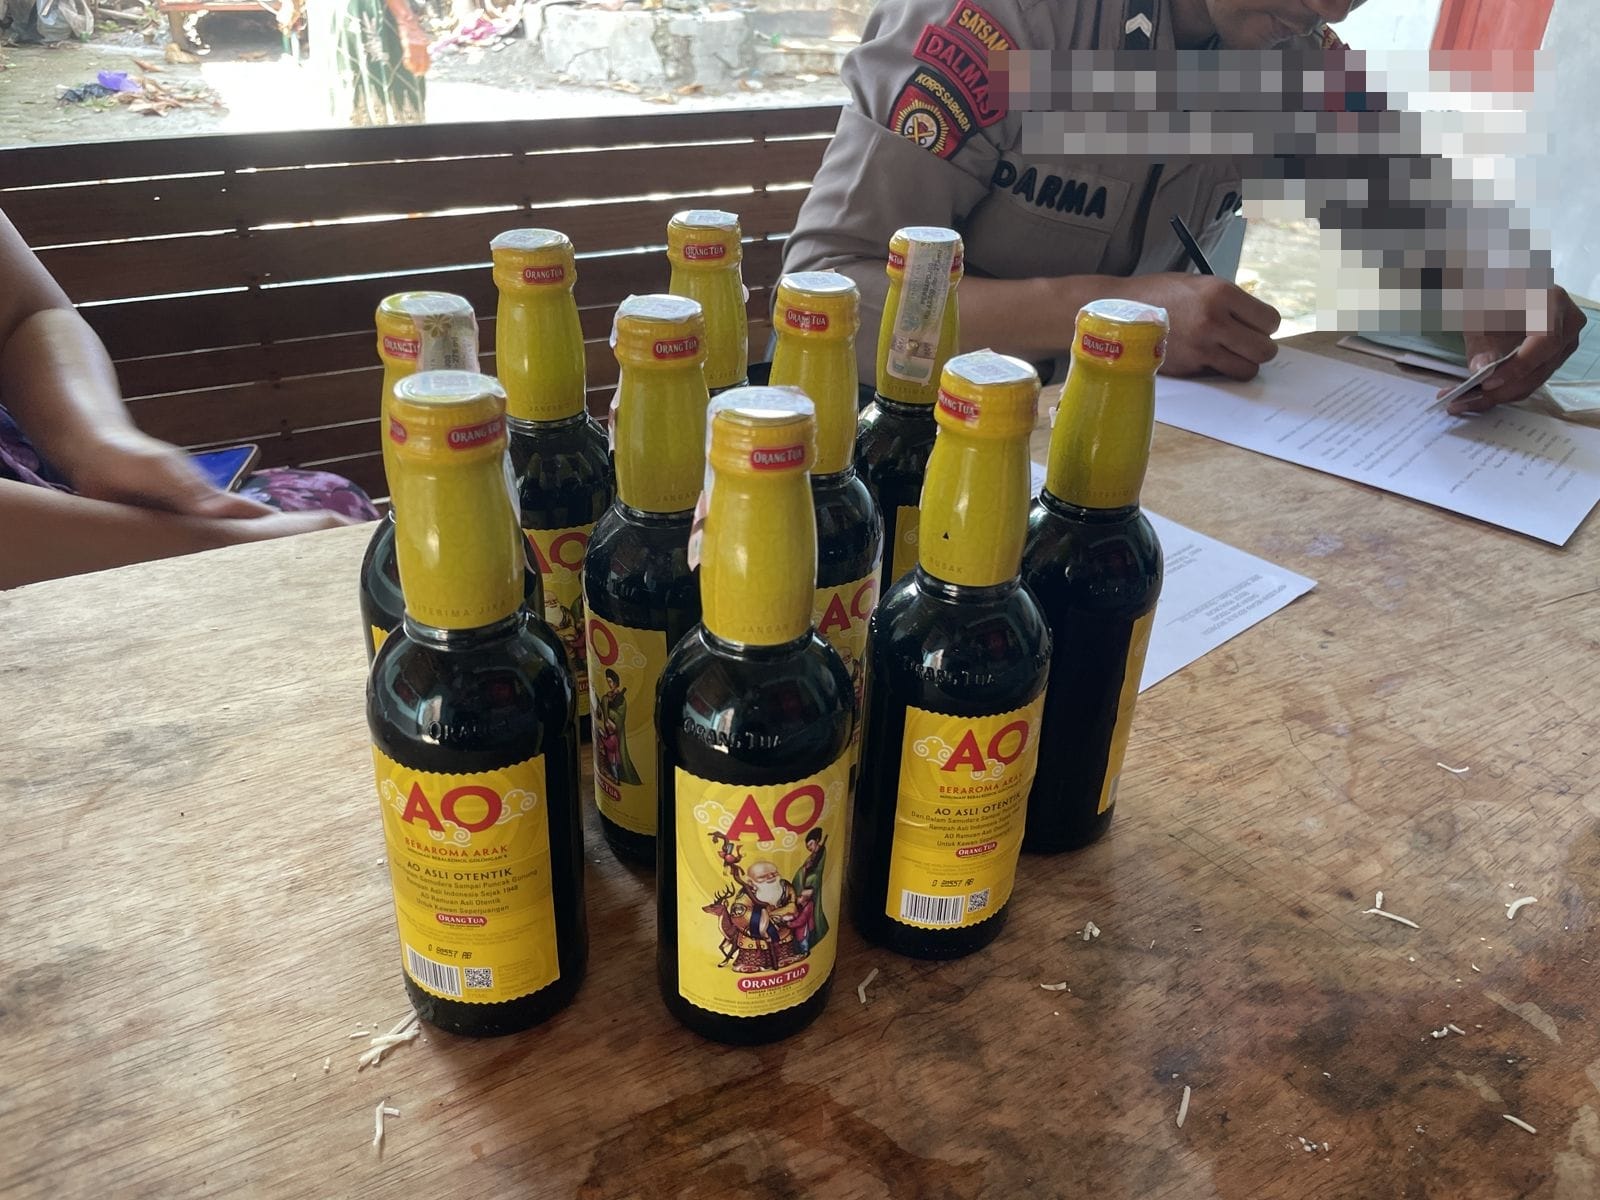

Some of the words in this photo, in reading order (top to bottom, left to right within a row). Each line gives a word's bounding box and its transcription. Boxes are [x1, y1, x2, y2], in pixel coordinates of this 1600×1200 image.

[992, 160, 1109, 220] DARMA
[685, 246, 709, 258] ORANG
[525, 269, 550, 280] ORANG
[656, 343, 683, 354] ORANG
[1105, 342, 1120, 354] TUA
[958, 400, 976, 415] TUA
[451, 428, 486, 443] ORANG
[753, 449, 782, 463] ORANG
[818, 578, 877, 635] AO
[940, 719, 1030, 772] AO
[939, 783, 1000, 794] BERAROMA
[401, 781, 503, 833] AO
[935, 808, 951, 816] AO
[955, 807, 979, 816] ASLI
[983, 792, 1021, 813] OTENTIK
[725, 784, 826, 841] AO
[404, 837, 468, 858] BERAROMA
[473, 844, 508, 858] ARAK
[958, 845, 983, 856] ORANG
[407, 860, 421, 873] AO
[424, 867, 449, 880] ASLI
[453, 867, 513, 881] OTENTIK
[438, 914, 467, 925] ORANG
[467, 917, 485, 925] TUA
[741, 976, 784, 989] ORANG
[784, 967, 807, 981] TUA
